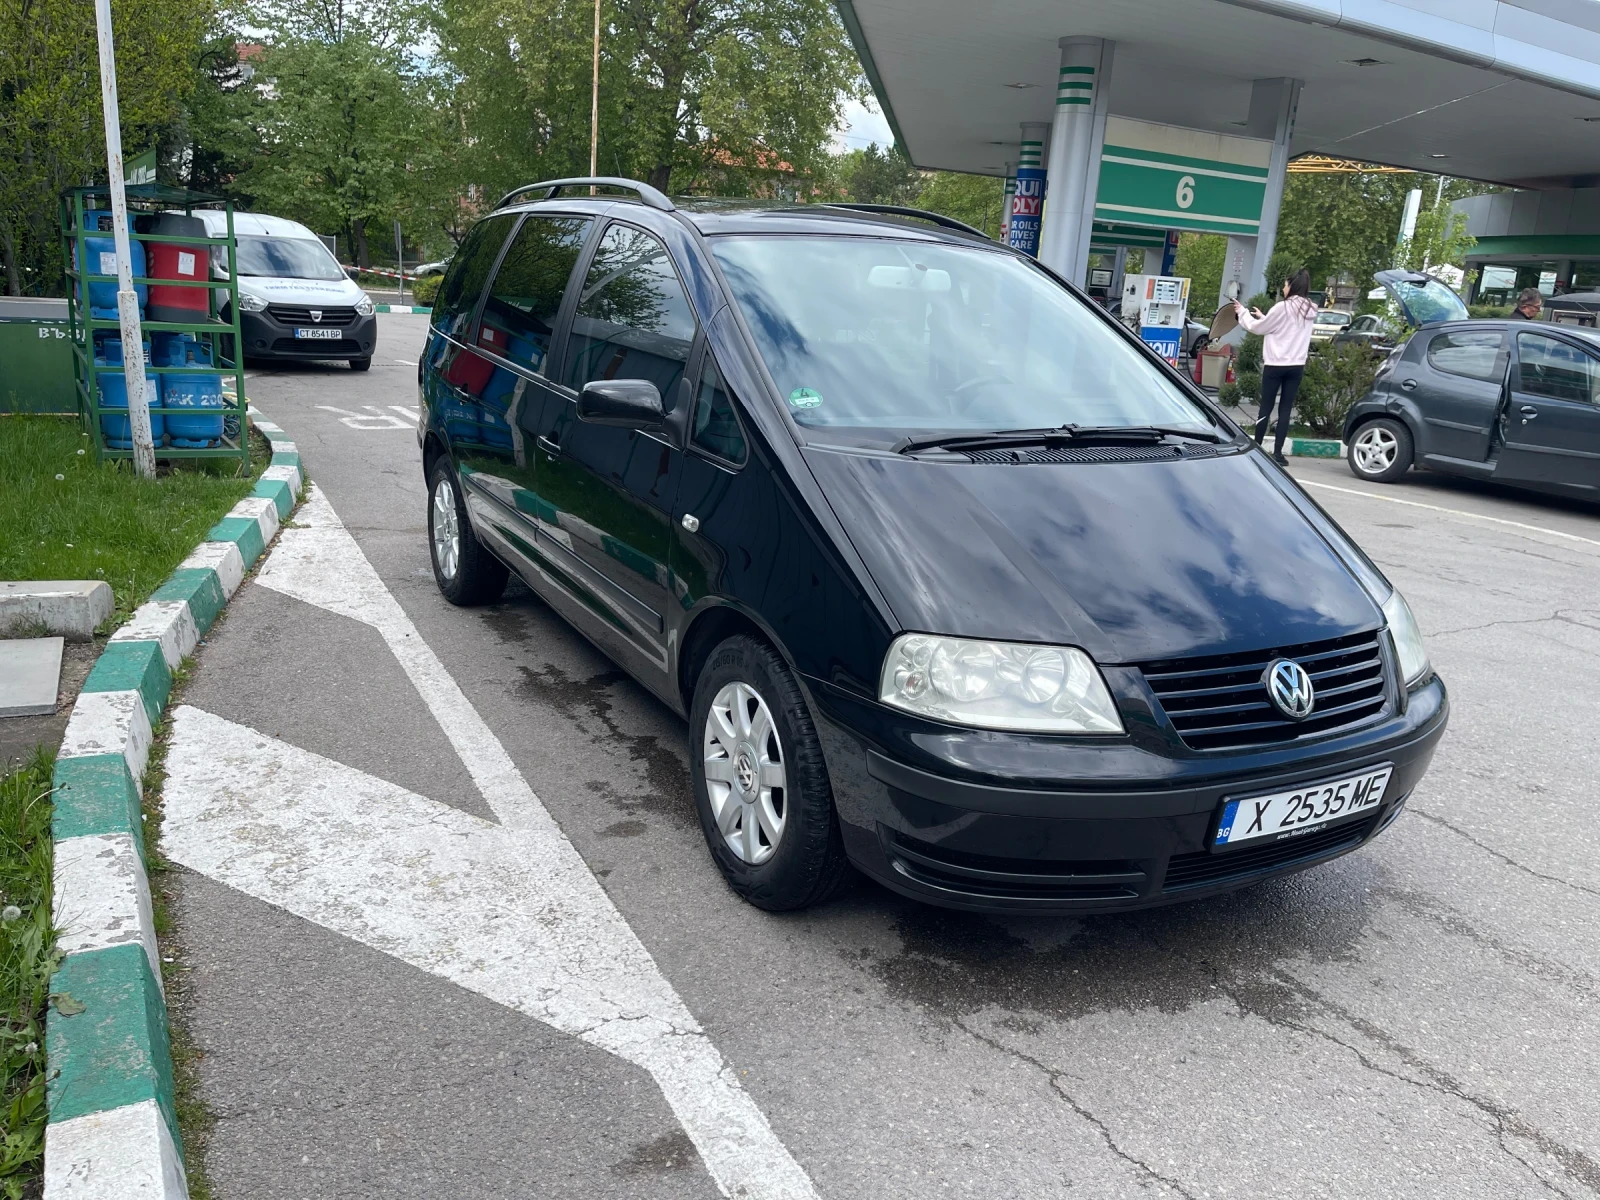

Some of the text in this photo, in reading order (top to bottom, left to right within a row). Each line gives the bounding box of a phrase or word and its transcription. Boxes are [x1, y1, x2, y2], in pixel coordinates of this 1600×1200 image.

[1176, 175, 1195, 209] 6
[1018, 220, 1038, 230] OILS
[1010, 240, 1032, 250] CARE
[300, 330, 310, 338] CT
[312, 330, 329, 338] 8541
[331, 330, 340, 338] BP
[1245, 772, 1387, 835] X 2535 ME
[1216, 827, 1231, 839] BG
